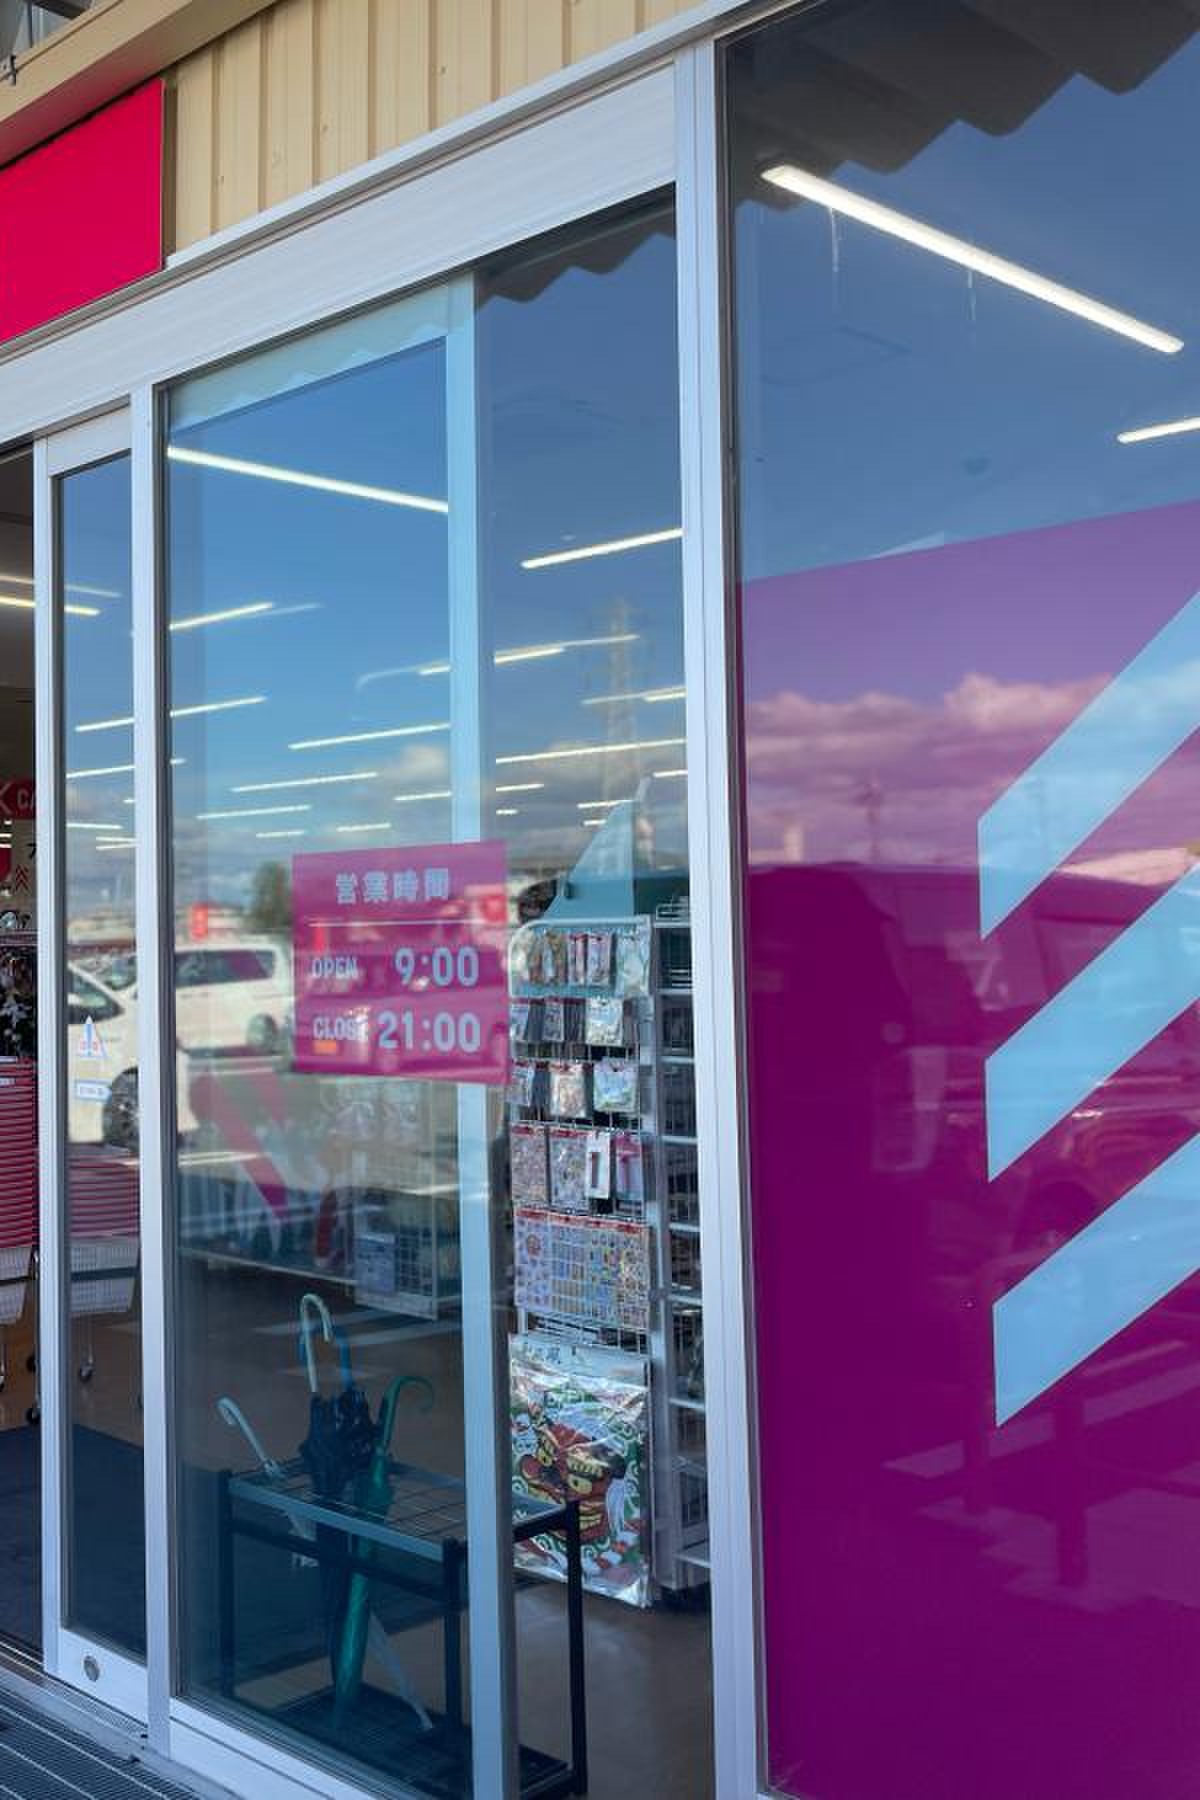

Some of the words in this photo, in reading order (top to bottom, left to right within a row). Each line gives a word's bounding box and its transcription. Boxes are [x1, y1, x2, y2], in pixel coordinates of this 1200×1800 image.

[335, 867, 450, 905] 営業時間
[311, 955, 359, 981] OPEN
[394, 946, 480, 987] 9:00
[376, 1009, 481, 1054] 21:00
